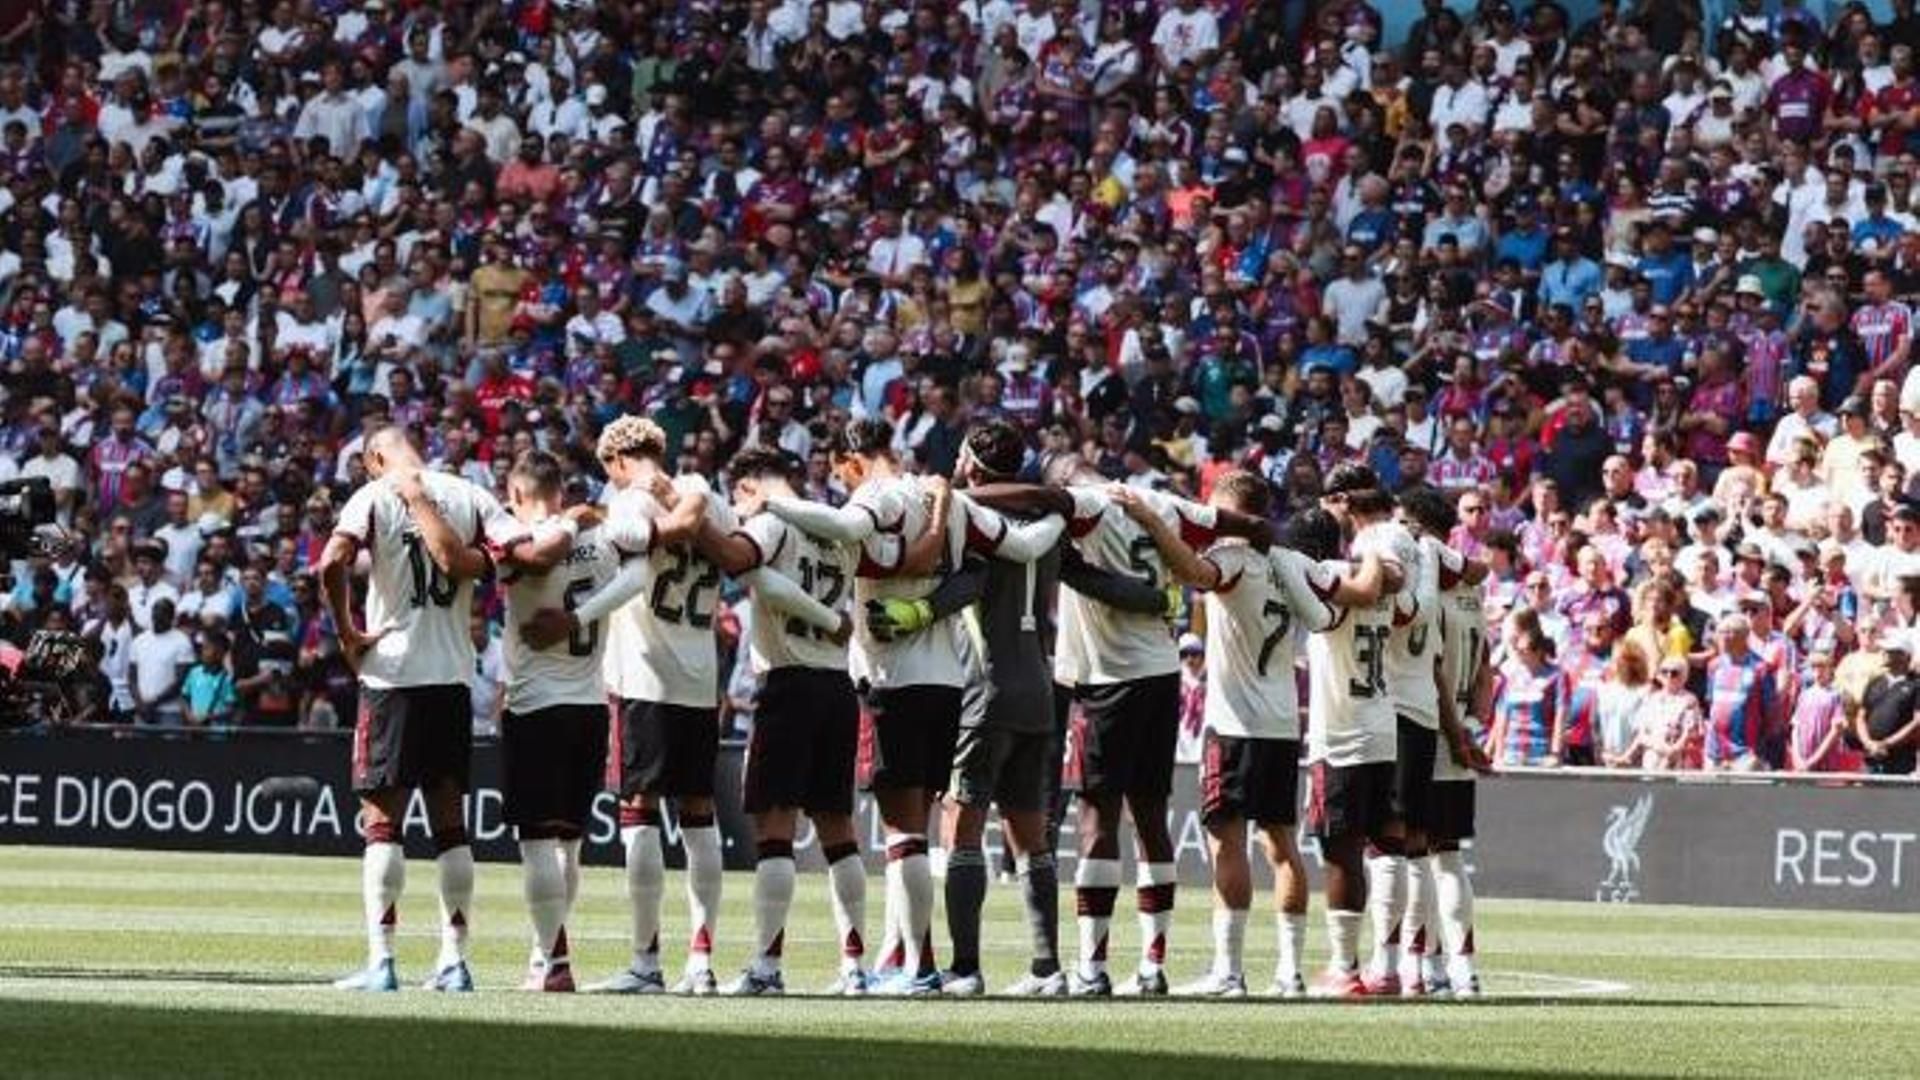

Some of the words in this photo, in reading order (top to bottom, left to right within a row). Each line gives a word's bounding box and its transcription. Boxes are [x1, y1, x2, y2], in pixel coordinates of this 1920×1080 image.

[650, 541, 717, 628] 22
[1258, 599, 1290, 676] 7
[54, 776, 214, 832] DIOGO
[1773, 828, 1916, 886] REST
